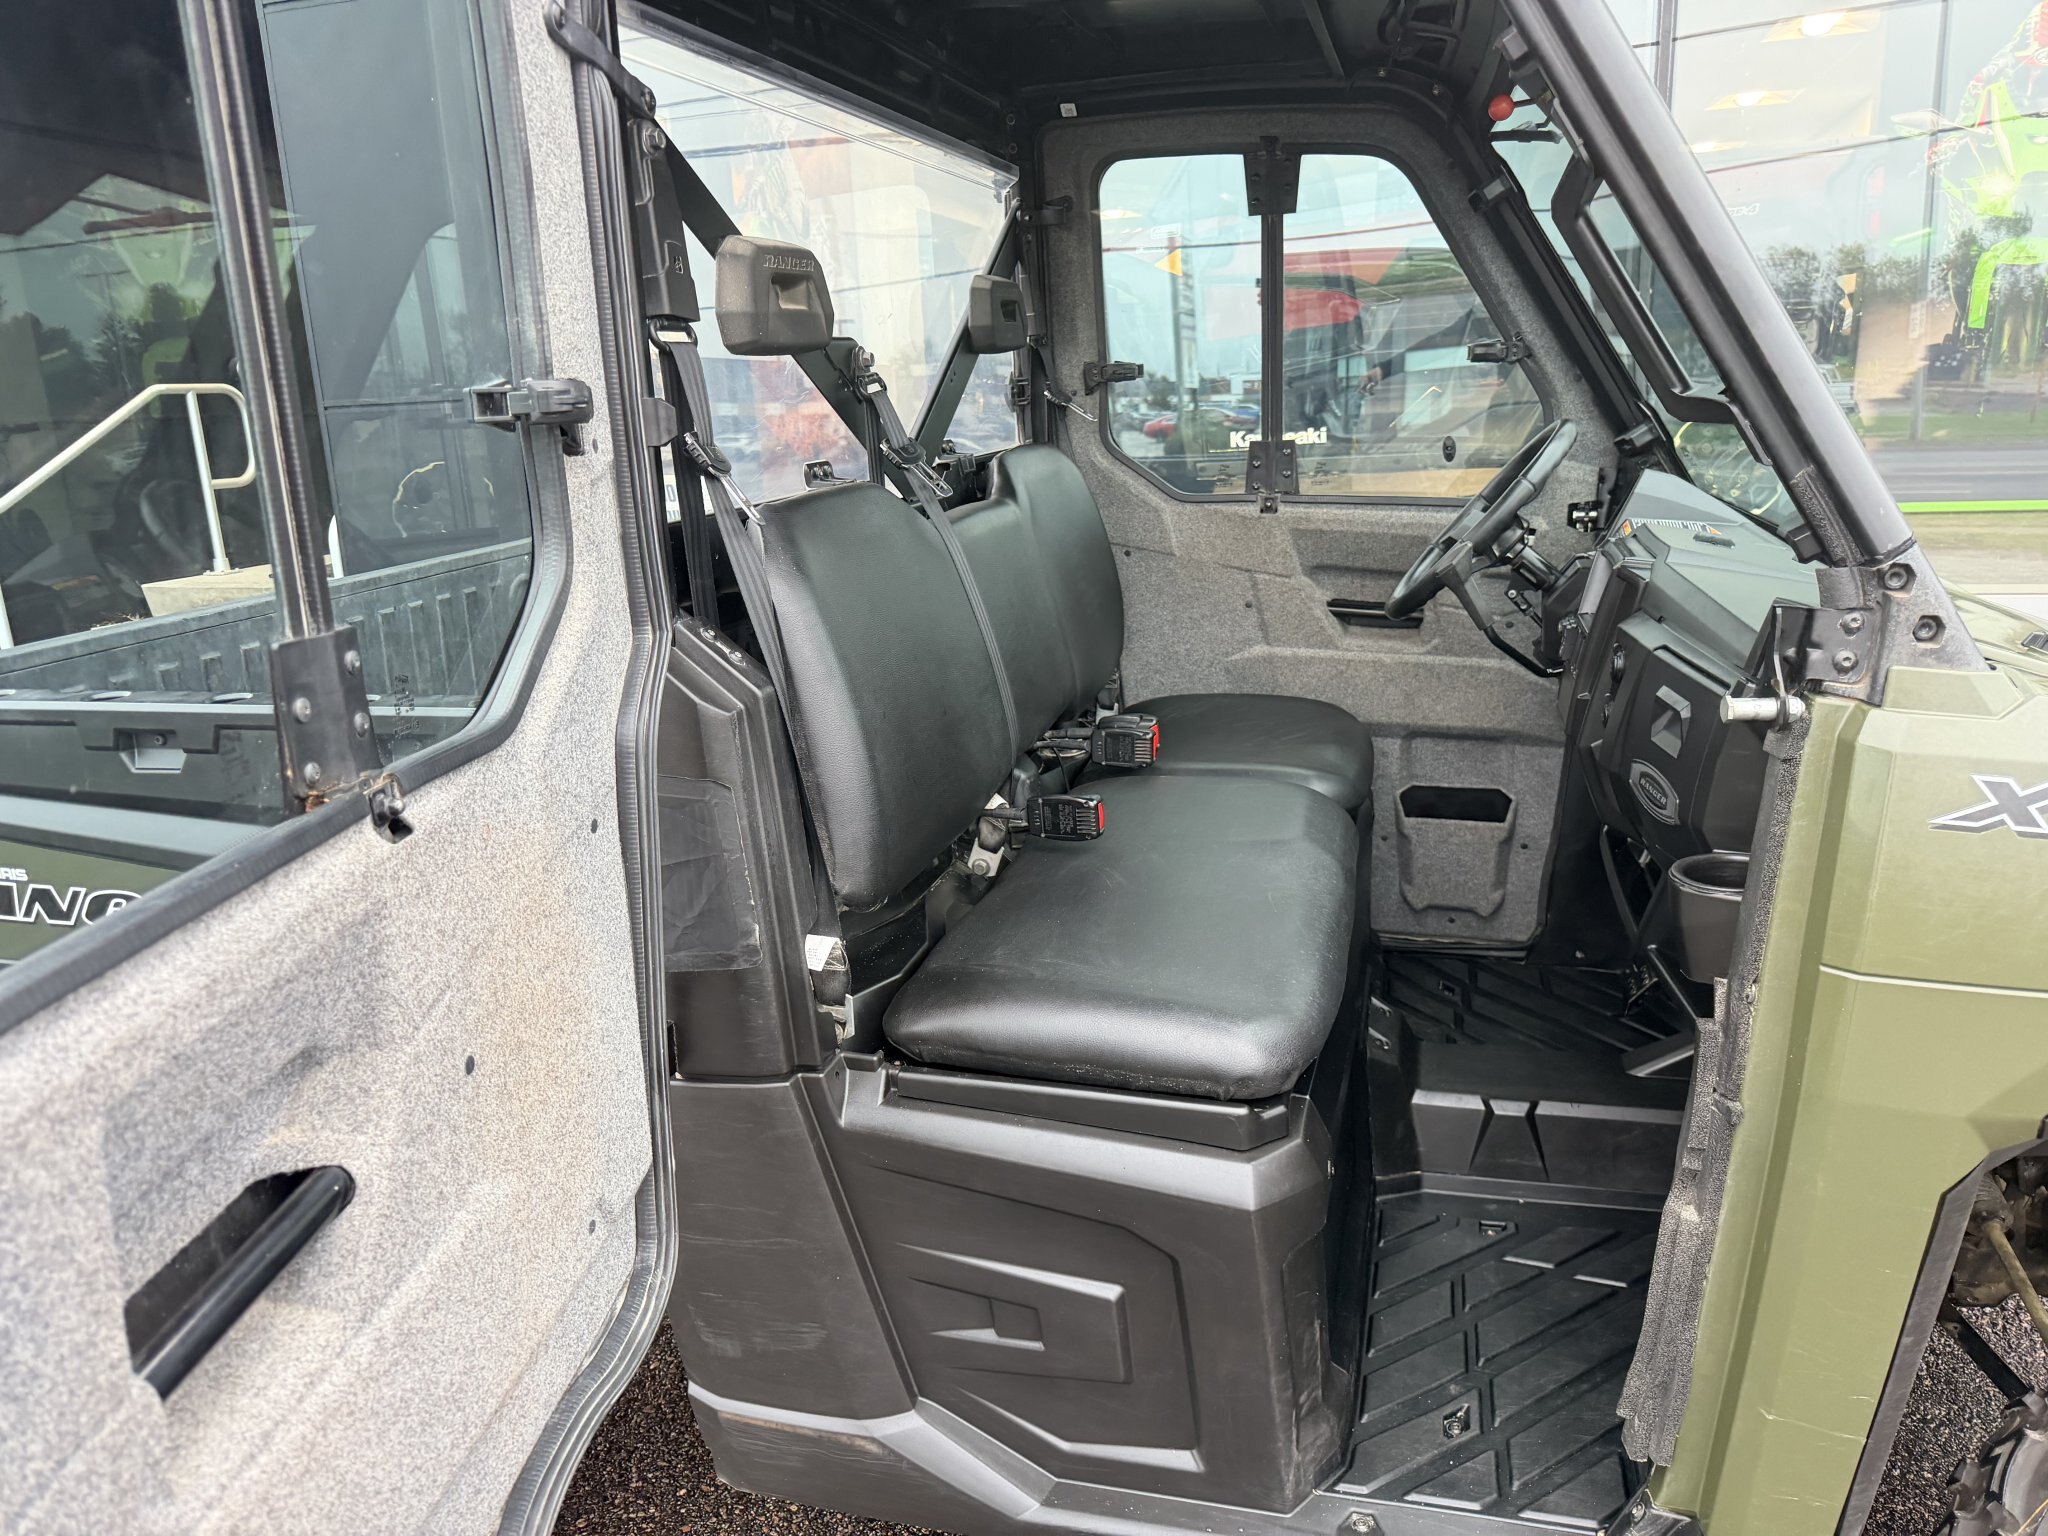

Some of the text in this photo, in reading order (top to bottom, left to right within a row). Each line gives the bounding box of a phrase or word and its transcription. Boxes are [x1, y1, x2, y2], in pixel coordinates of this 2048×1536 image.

[763, 254, 815, 272] RANGER
[1229, 426, 1328, 448] Kasaki
[1639, 777, 1668, 805] RANGER
[0, 867, 29, 881] RIS
